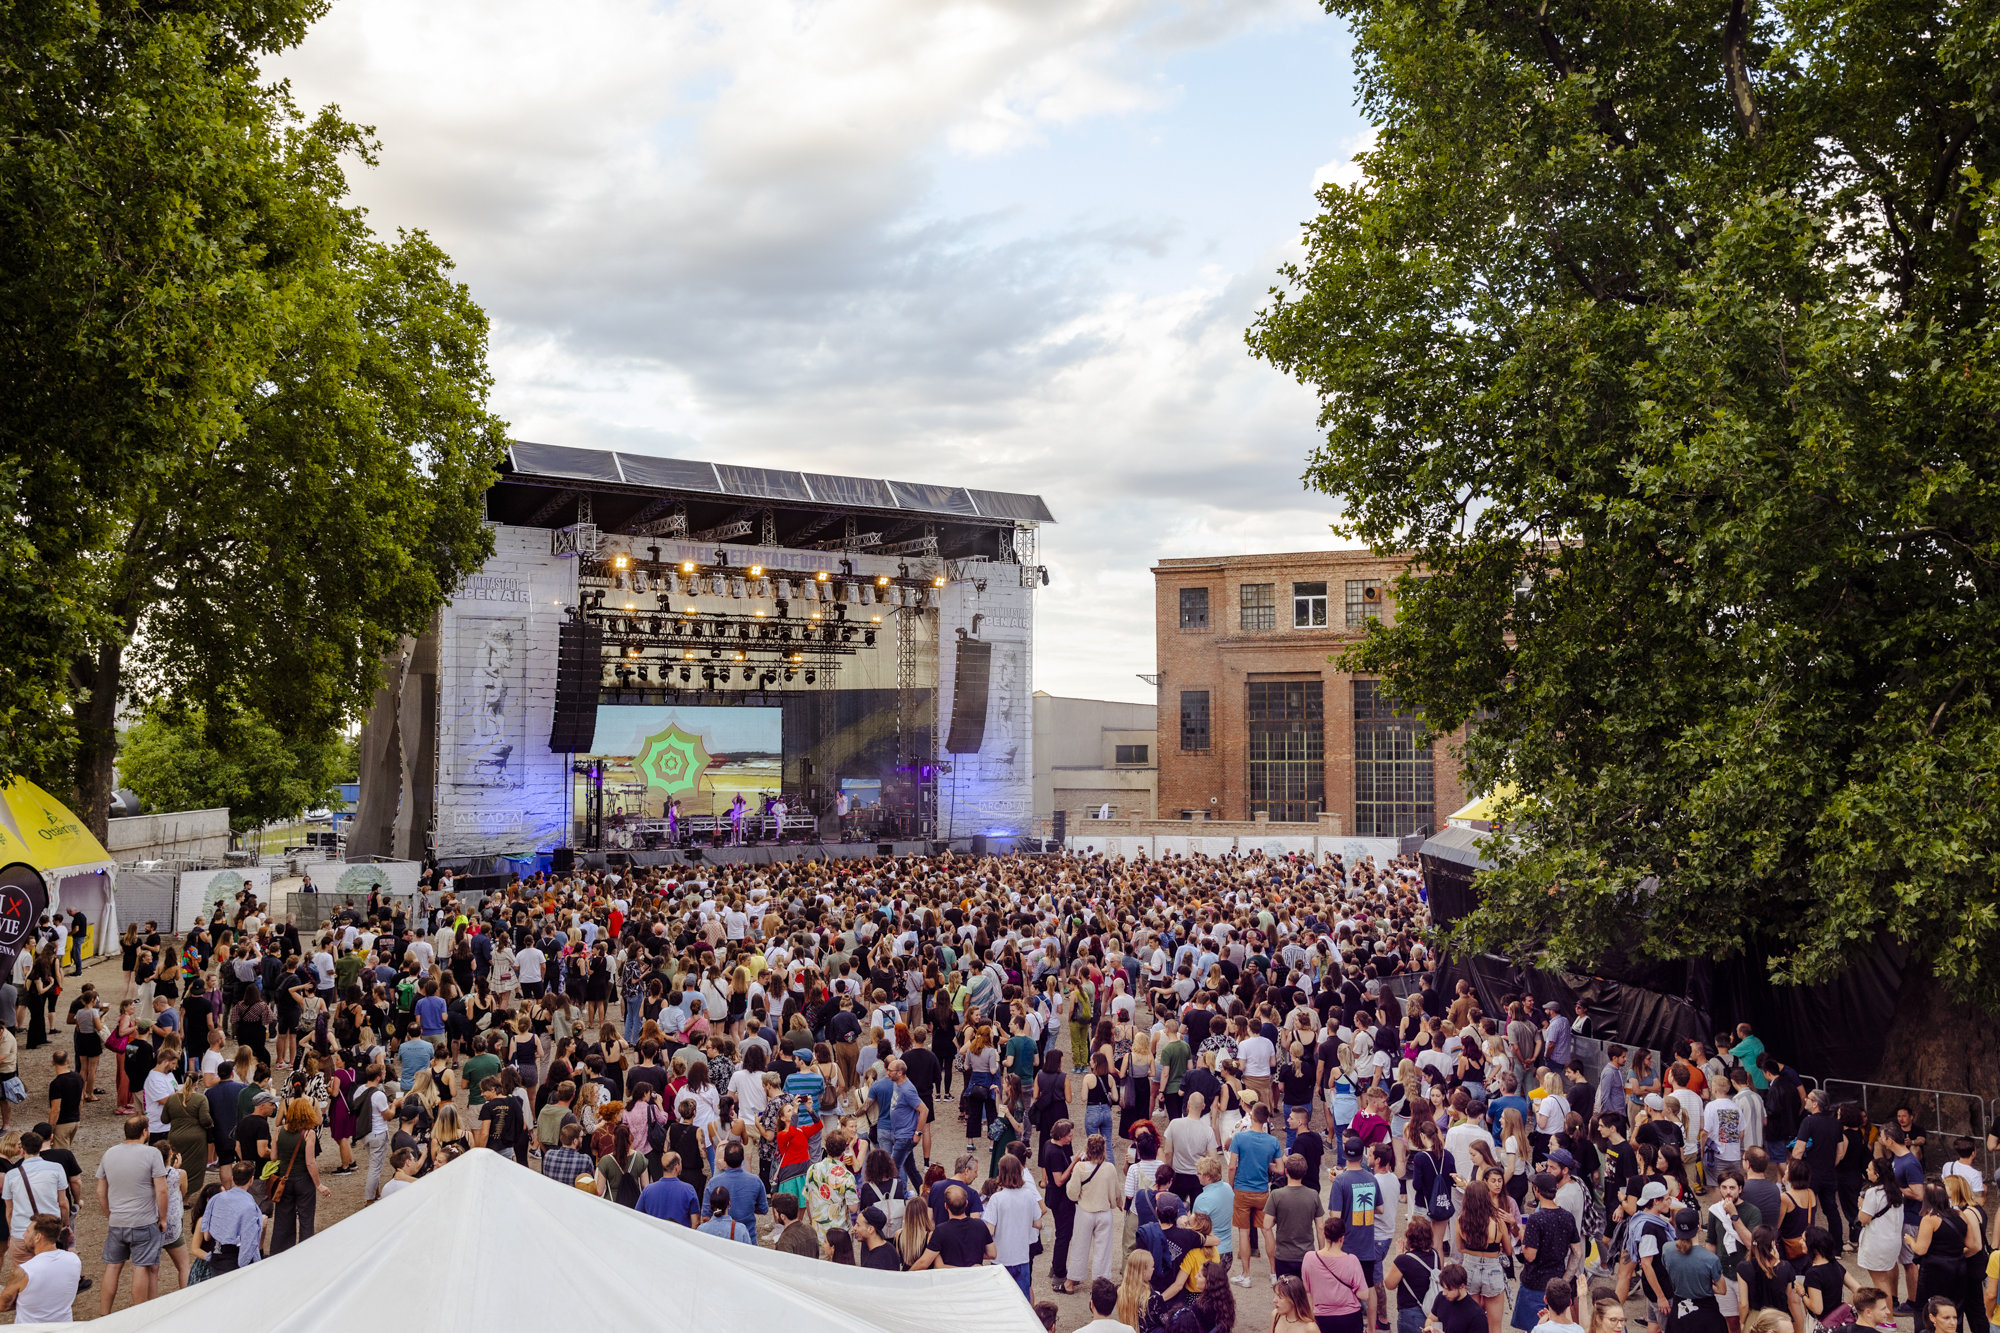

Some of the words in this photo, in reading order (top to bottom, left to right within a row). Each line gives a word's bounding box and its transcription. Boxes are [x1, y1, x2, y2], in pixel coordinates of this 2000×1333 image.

[676, 545, 714, 562] WIEN
[800, 555, 833, 571] OPEN
[501, 589, 530, 602] AIR
